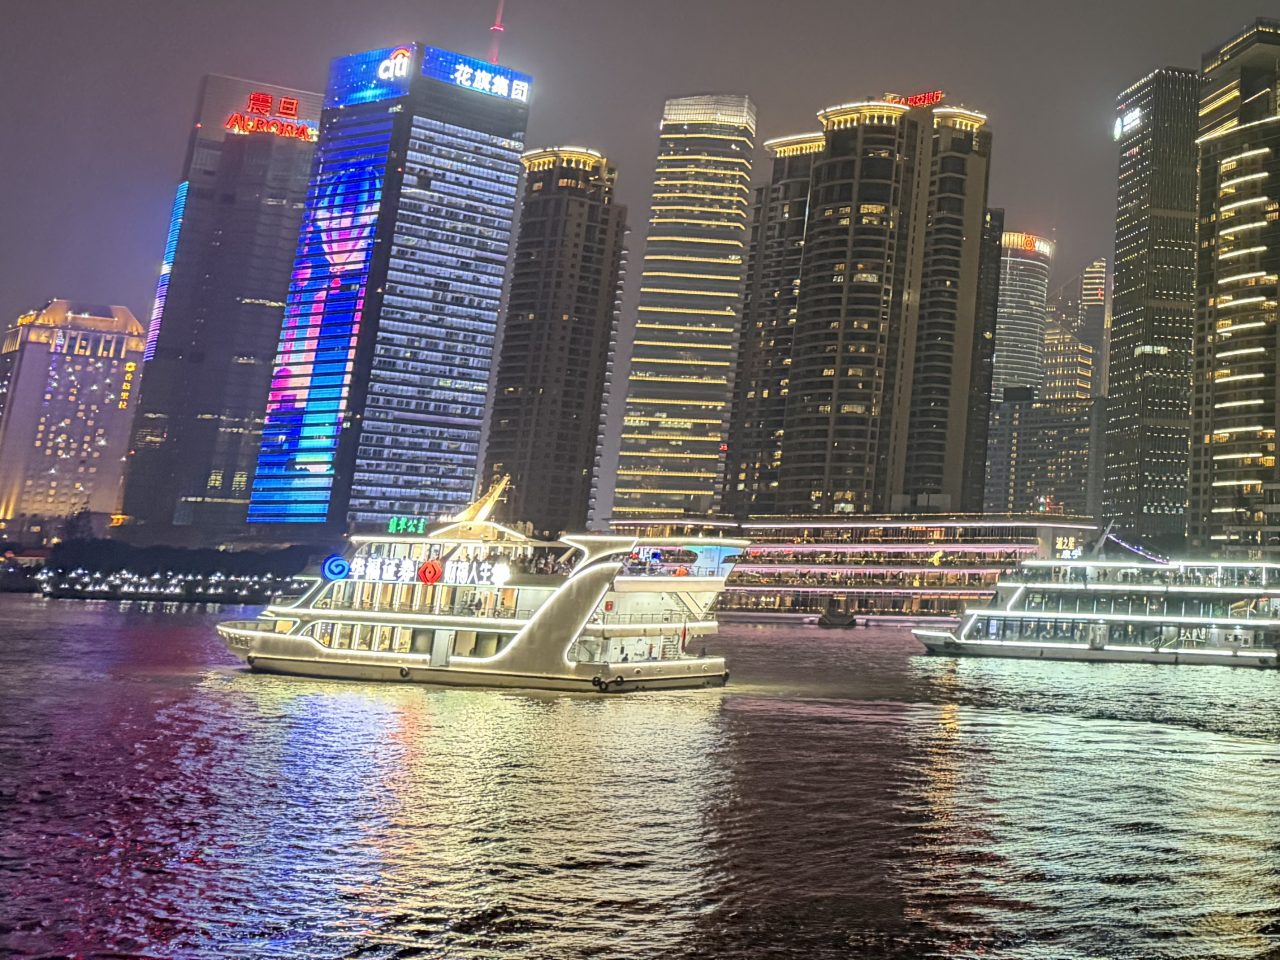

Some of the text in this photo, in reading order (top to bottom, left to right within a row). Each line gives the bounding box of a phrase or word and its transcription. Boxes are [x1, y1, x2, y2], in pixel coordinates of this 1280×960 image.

[378, 54, 409, 80] citi
[454, 63, 529, 103] 花旗集团
[246, 92, 299, 119] 震旦
[224, 112, 312, 142] AURORA
[349, 557, 416, 582] 华福证券
